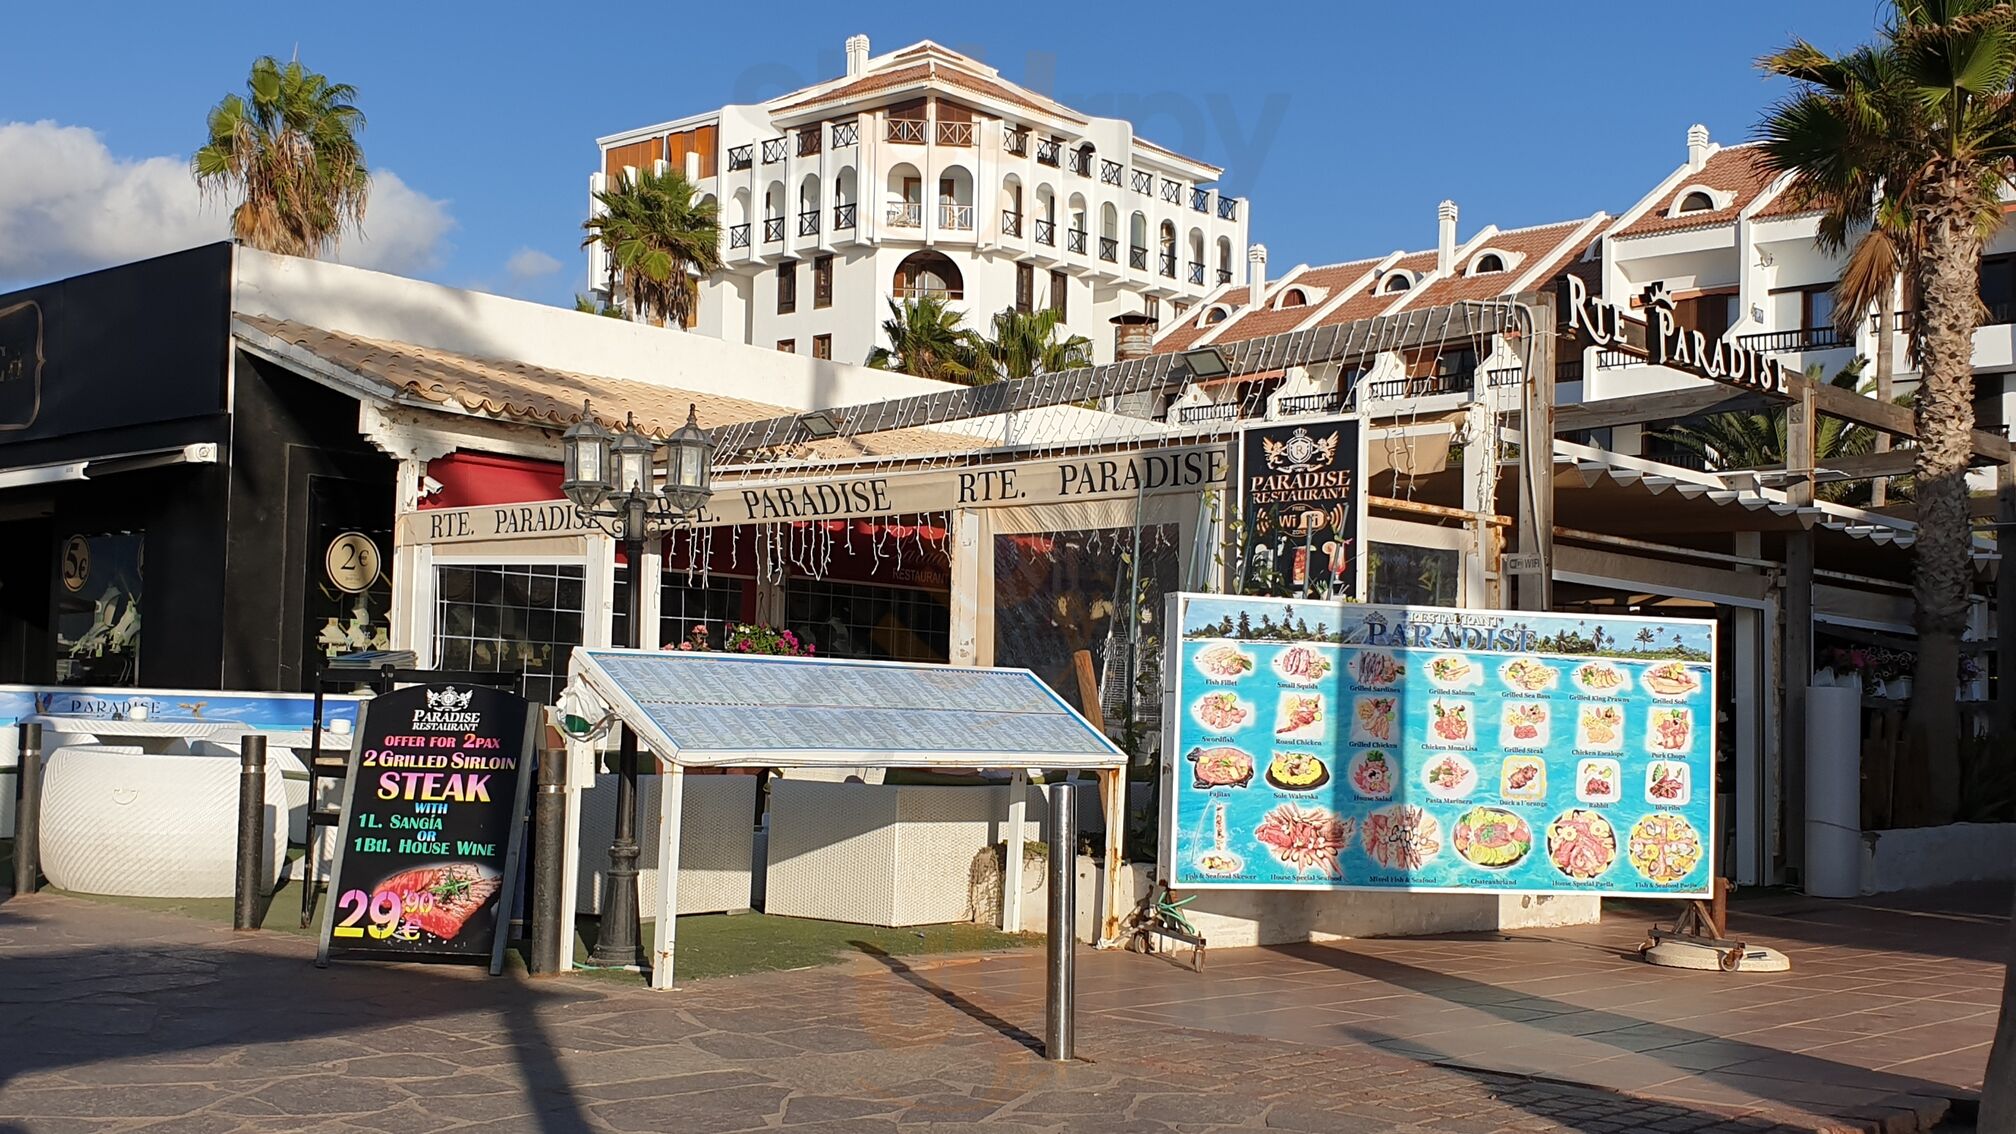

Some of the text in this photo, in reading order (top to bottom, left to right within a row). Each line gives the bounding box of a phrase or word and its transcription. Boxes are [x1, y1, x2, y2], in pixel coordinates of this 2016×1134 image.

[1656, 305, 1789, 394] PARADISE
[958, 450, 1228, 504] RTE. PARADISE
[1251, 470, 1350, 492] PARADISE
[657, 479, 892, 525] RE. PARADISE
[1253, 487, 1350, 504] RESTAURANT
[430, 512, 475, 539] RTE.
[341, 543, 369, 570] 2€
[1409, 612, 1502, 627] RESTAURANT
[1367, 622, 1537, 652] PARADISE
[1296, 683, 1318, 691] Squids
[1536, 692, 1551, 700] Bass
[1592, 695, 1605, 703] King
[413, 709, 480, 724] PARADISE
[412, 723, 478, 732] RESTAURANT
[384, 734, 501, 748] OFFER FOR 2PAX
[363, 750, 517, 770] 2 GRILLED SIRLOIN
[377, 771, 492, 802] STEAK
[415, 803, 448, 814] WITH
[359, 813, 382, 828] 1L.
[417, 831, 437, 842] OR
[399, 839, 450, 854] HOUSE
[457, 840, 496, 856] WINE
[1291, 875, 1316, 883] Special
[334, 889, 401, 939] 29
